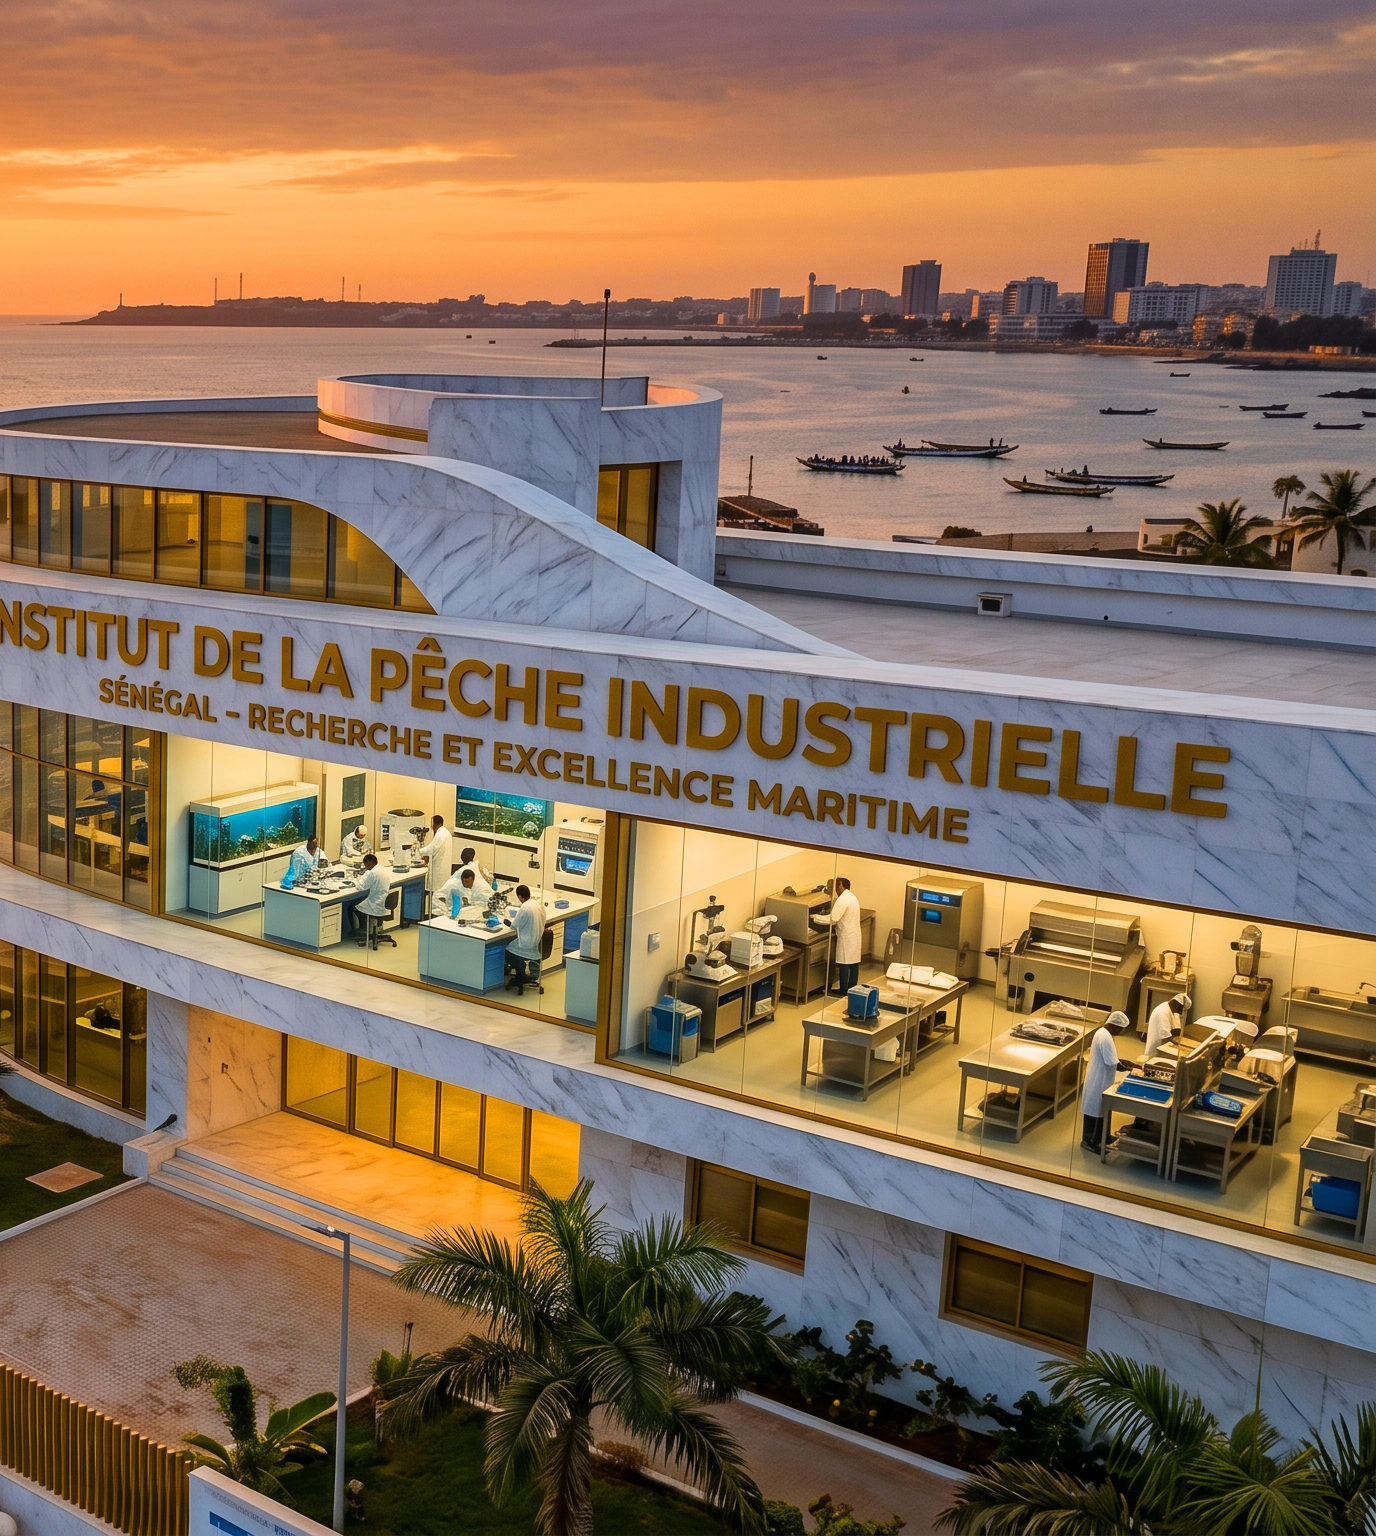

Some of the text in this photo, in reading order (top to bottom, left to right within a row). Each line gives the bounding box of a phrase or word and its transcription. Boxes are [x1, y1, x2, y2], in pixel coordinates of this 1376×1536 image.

[99, 675, 217, 723] SÉNÉGAL
[248, 703, 431, 759] RECHERCHE
[442, 734, 482, 766] ET
[493, 741, 733, 808] EXCELLENCE
[748, 780, 968, 844] MARITIME
[194, 625, 263, 685] DE
[281, 636, 354, 699] LA
[370, 636, 583, 732] PÊCHE
[607, 677, 1230, 818] INDUSTRIELLE
